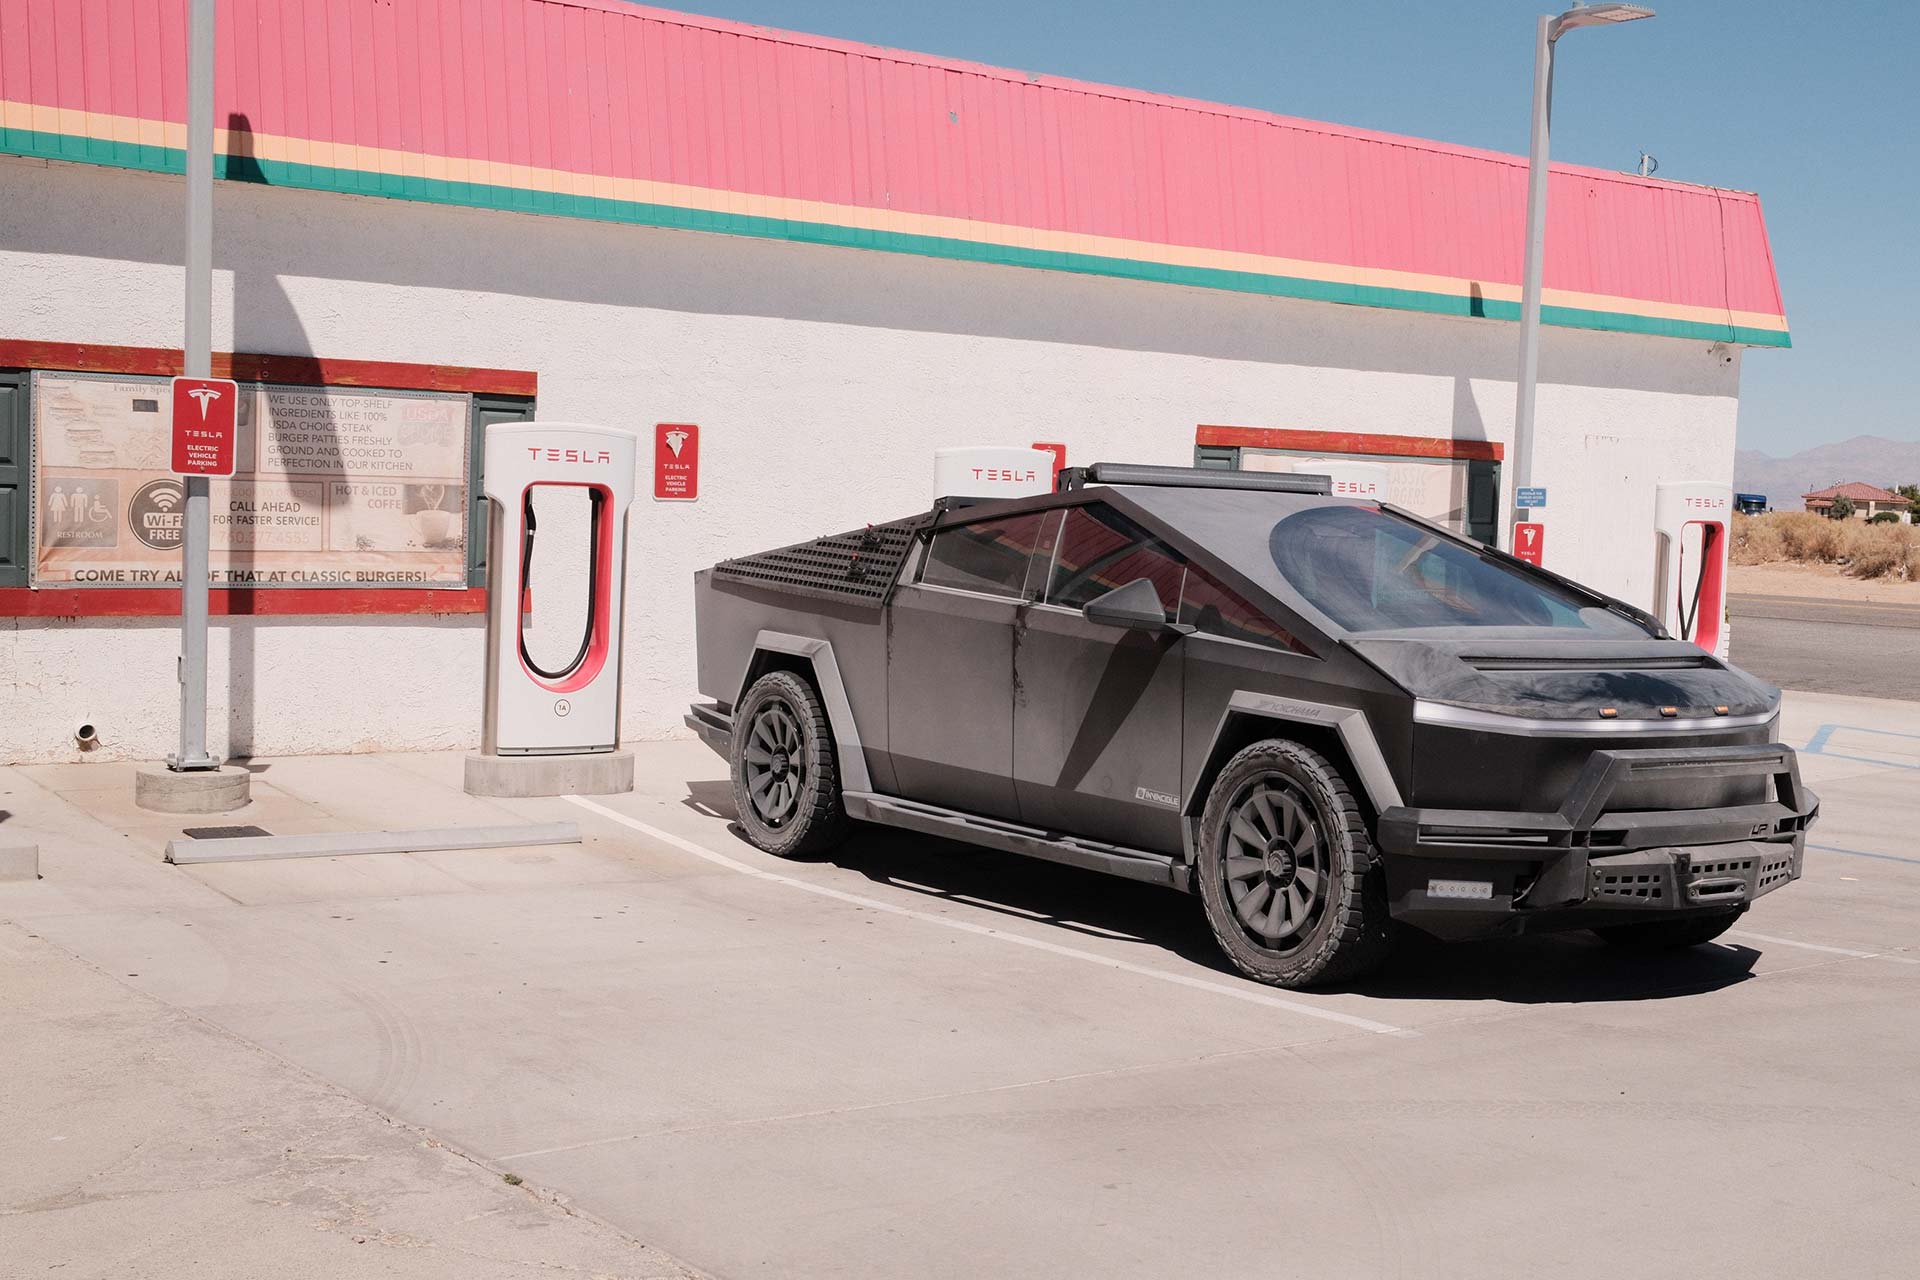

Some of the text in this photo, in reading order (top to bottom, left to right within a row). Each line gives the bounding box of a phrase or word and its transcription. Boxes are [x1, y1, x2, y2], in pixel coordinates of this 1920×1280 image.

[269, 395, 393, 409] WE USE ONLY TOP-SHELF
[269, 408, 388, 422] INGREDIENTS LIKE 100%
[268, 420, 373, 433] USDA CHOICE STEAK
[185, 430, 223, 438] TESLA
[268, 433, 393, 445] BURGER PATTIES FRESHLY
[268, 445, 403, 458] GROUND AND COOKED TO
[527, 447, 610, 464] TESLA
[267, 458, 413, 471] PERFECTION IN OUR KITCHEN
[970, 468, 1037, 482] TESLA
[335, 485, 397, 497] HOT & ICED
[1332, 481, 1376, 494] ESLA
[229, 500, 301, 513] CALL AHEAD
[1684, 497, 1725, 508] TESLA
[147, 515, 183, 526] Wi-Fi
[213, 515, 320, 526] FOR FASTER SERVICE!
[150, 529, 180, 540] FREE
[74, 569, 427, 582] COME TRY AL F THAT AT CLASSIC BURGERS!
[1271, 703, 1321, 718] YOKOHAMA
